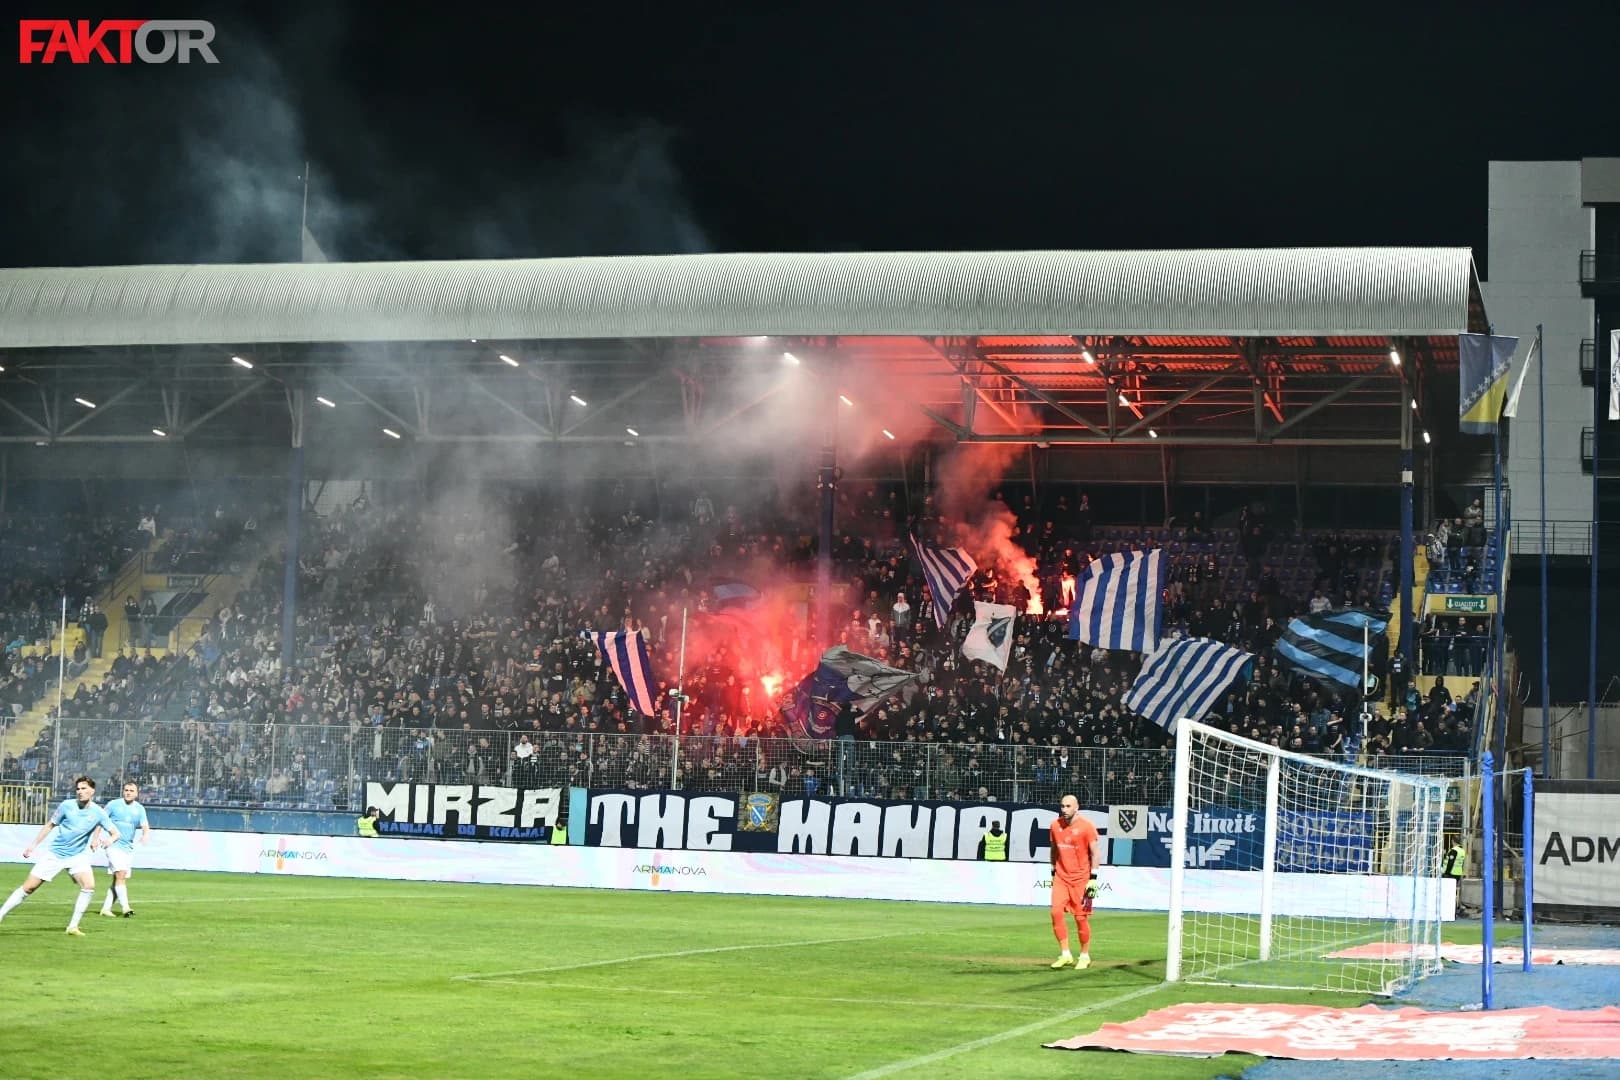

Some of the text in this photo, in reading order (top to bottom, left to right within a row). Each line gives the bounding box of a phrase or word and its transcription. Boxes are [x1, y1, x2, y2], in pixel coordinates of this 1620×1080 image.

[366, 783, 561, 826] MIRZA
[589, 793, 735, 851] THE
[1193, 813, 1258, 834] limit
[259, 849, 328, 860] ARMANOVA
[632, 863, 707, 876] ARMANOVA
